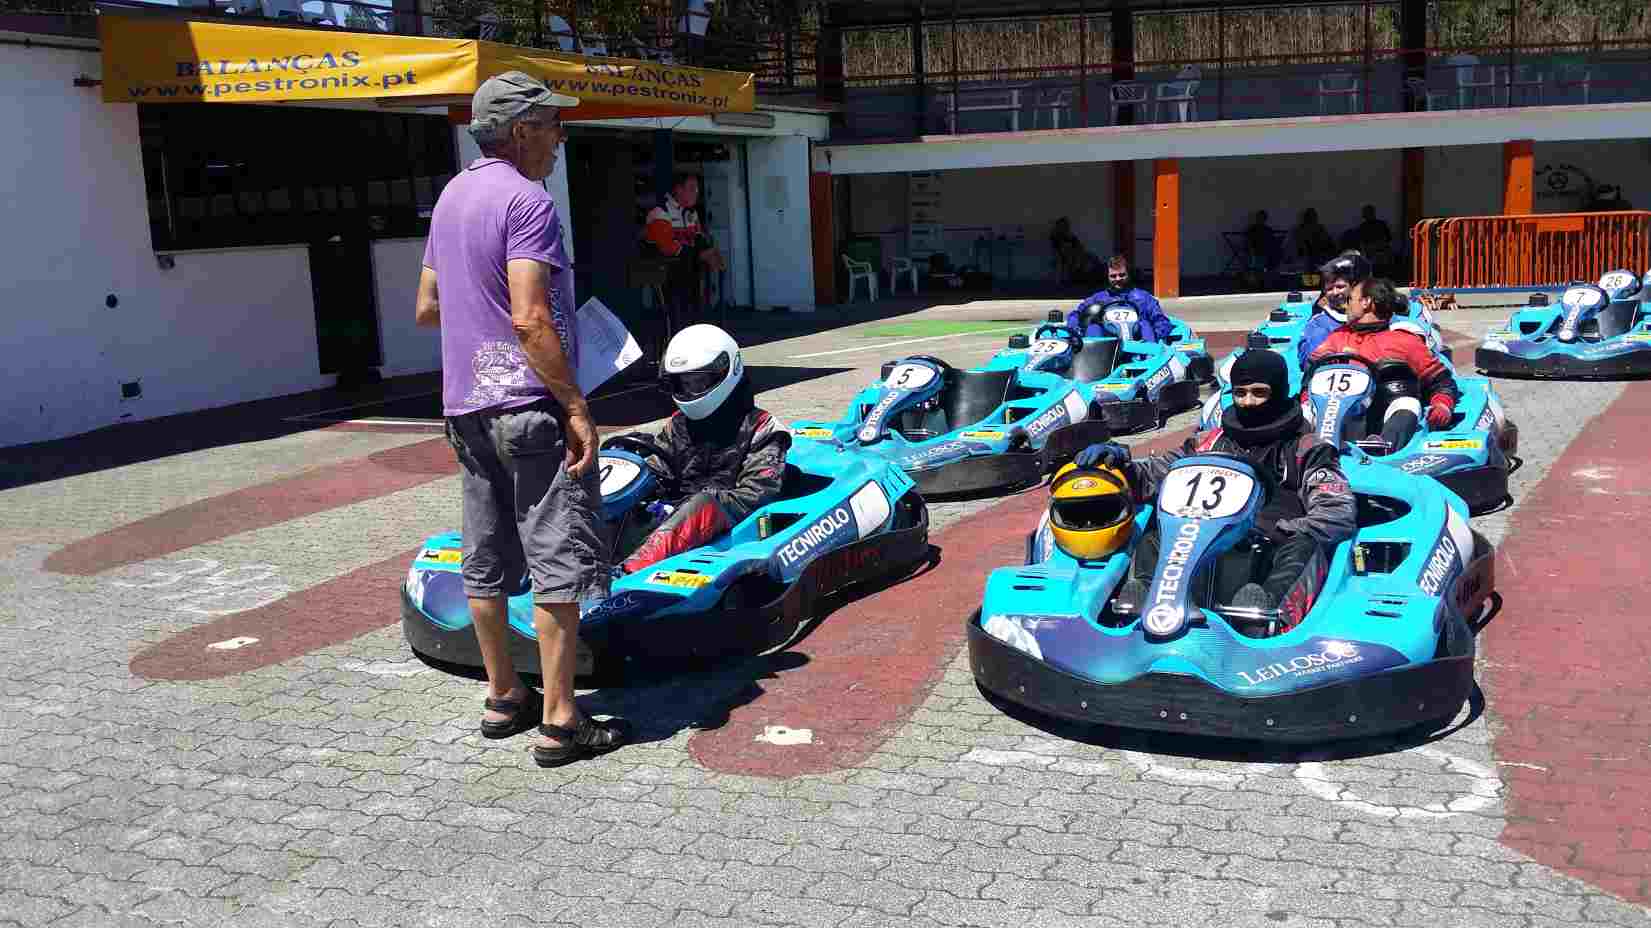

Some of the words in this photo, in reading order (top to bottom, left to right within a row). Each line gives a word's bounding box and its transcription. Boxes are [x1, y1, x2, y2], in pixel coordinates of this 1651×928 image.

[176, 51, 361, 77] BALANÇAS
[128, 69, 417, 98] www.pestronix.pt
[1576, 292, 1585, 304] 7
[1114, 310, 1130, 321] 27
[897, 368, 914, 385] 5
[1327, 373, 1352, 392] 15
[1186, 472, 1227, 511] 13
[777, 508, 850, 567] TECNIROLO
[1156, 519, 1200, 604] TECNIROLO
